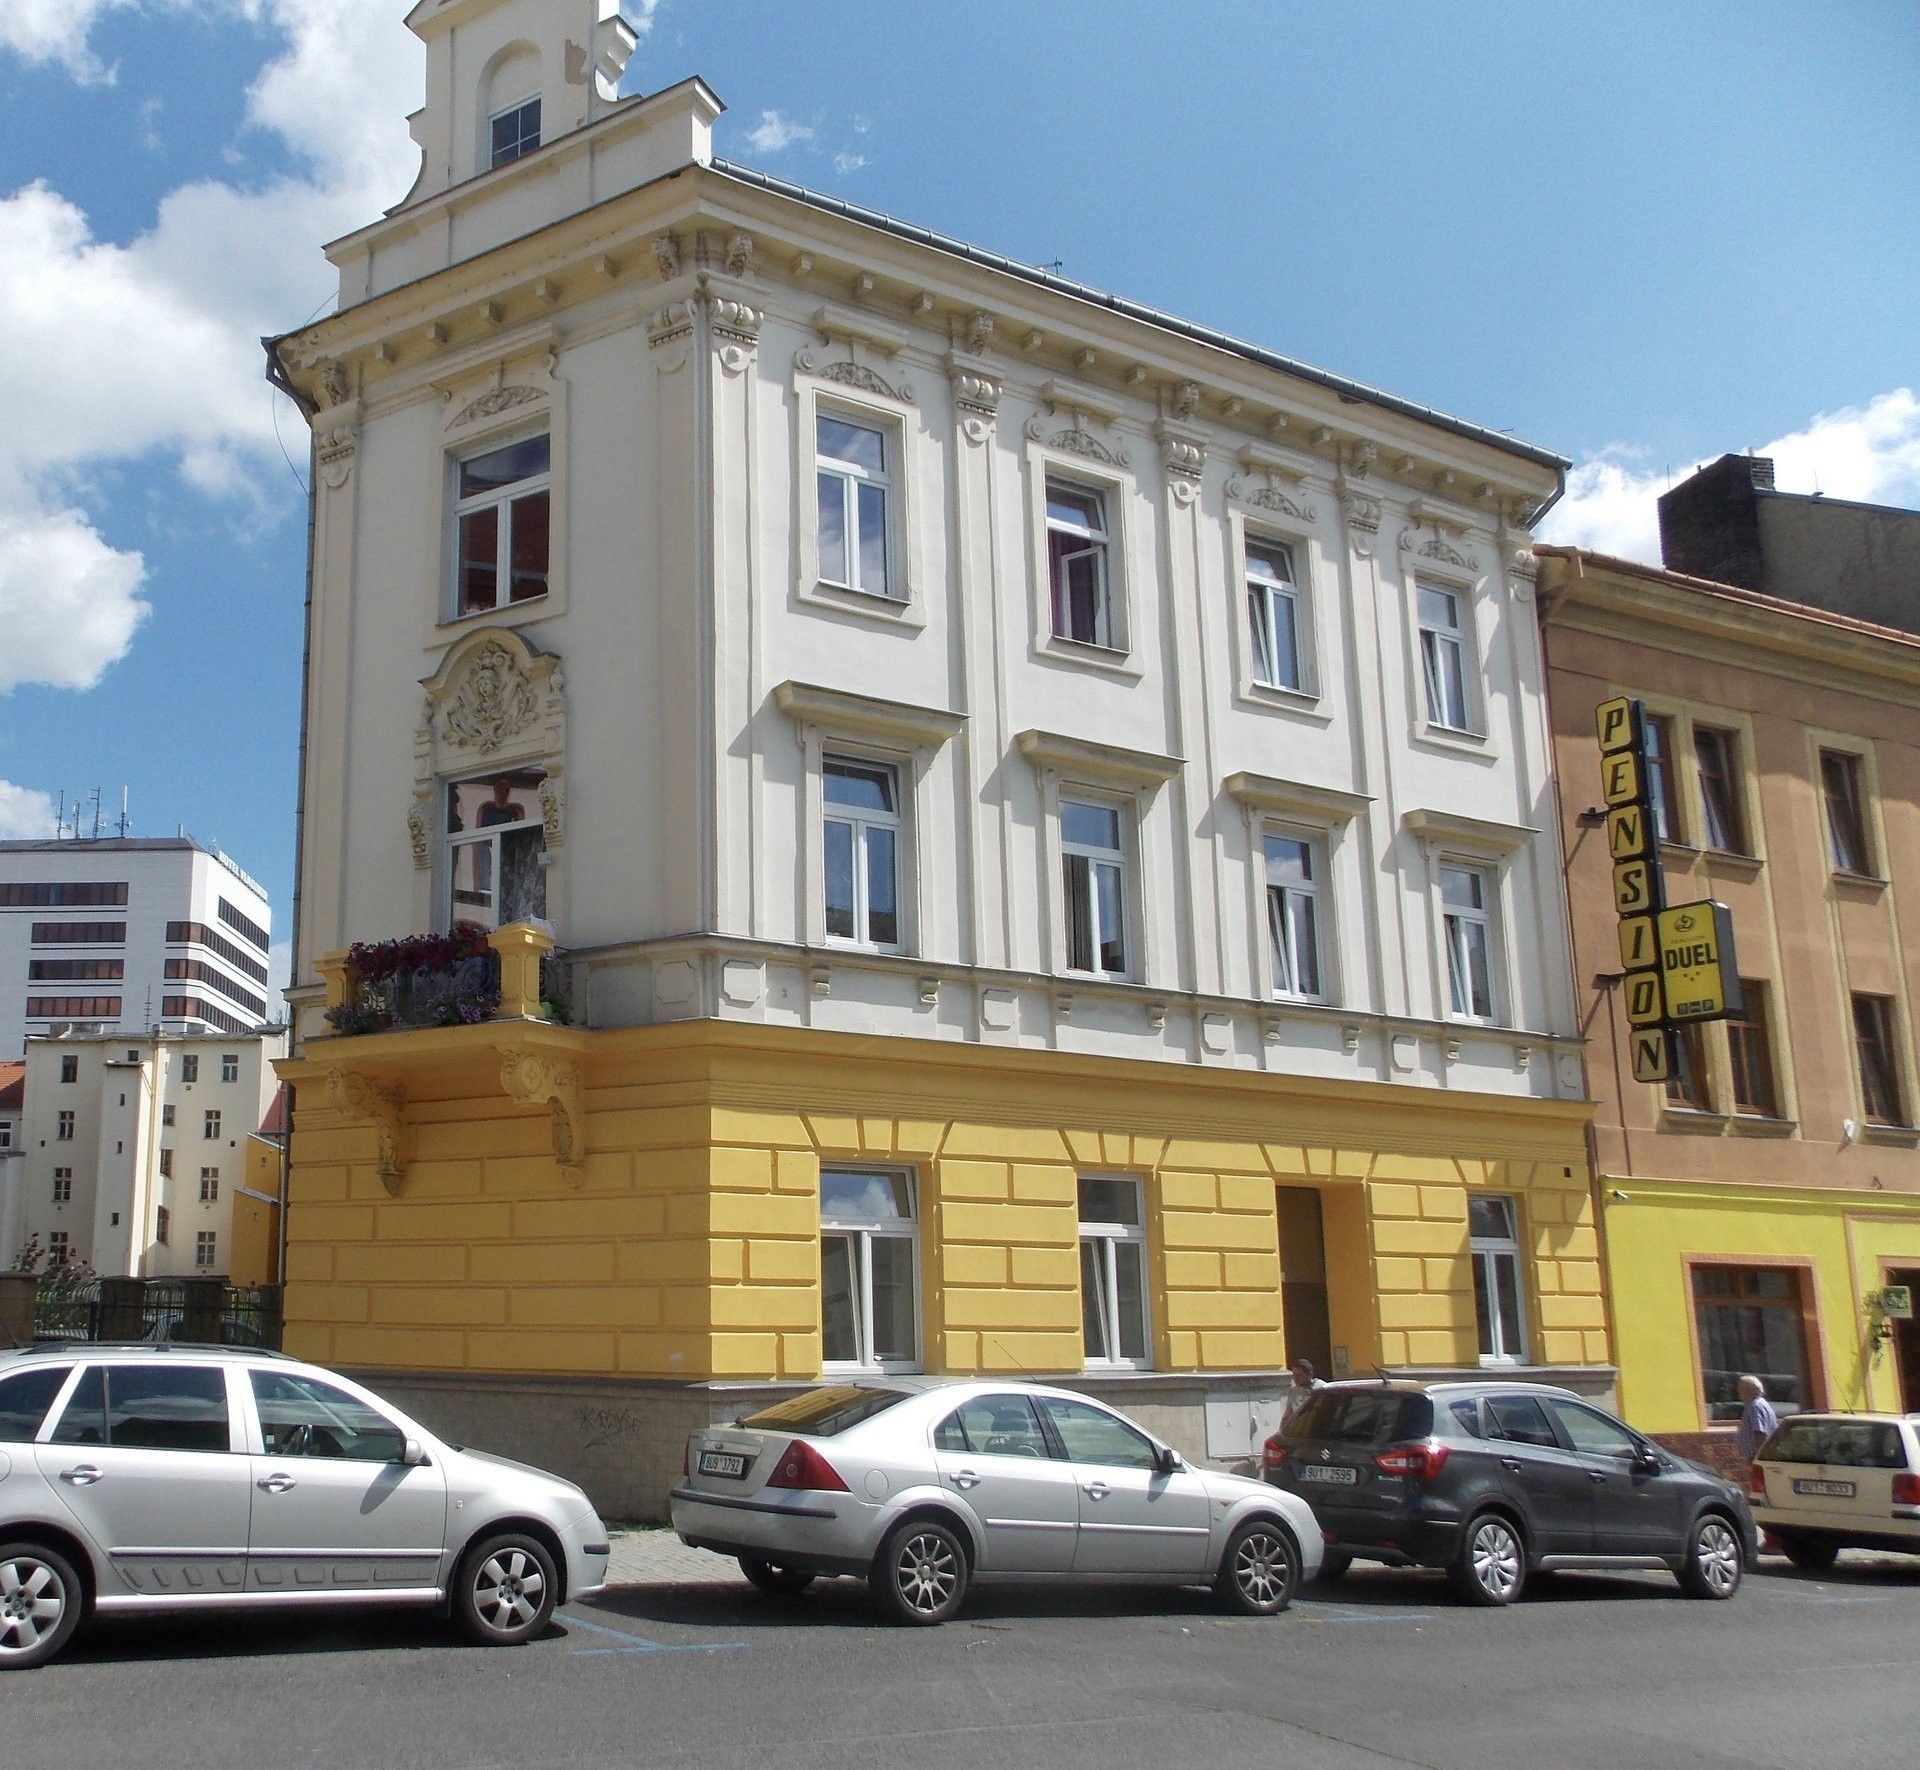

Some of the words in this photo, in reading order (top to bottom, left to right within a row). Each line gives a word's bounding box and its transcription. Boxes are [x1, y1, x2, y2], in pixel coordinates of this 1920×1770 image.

[1603, 706, 1661, 1074] PENSION
[1664, 942, 1718, 971] DUEL
[722, 1458, 740, 1473] 3792
